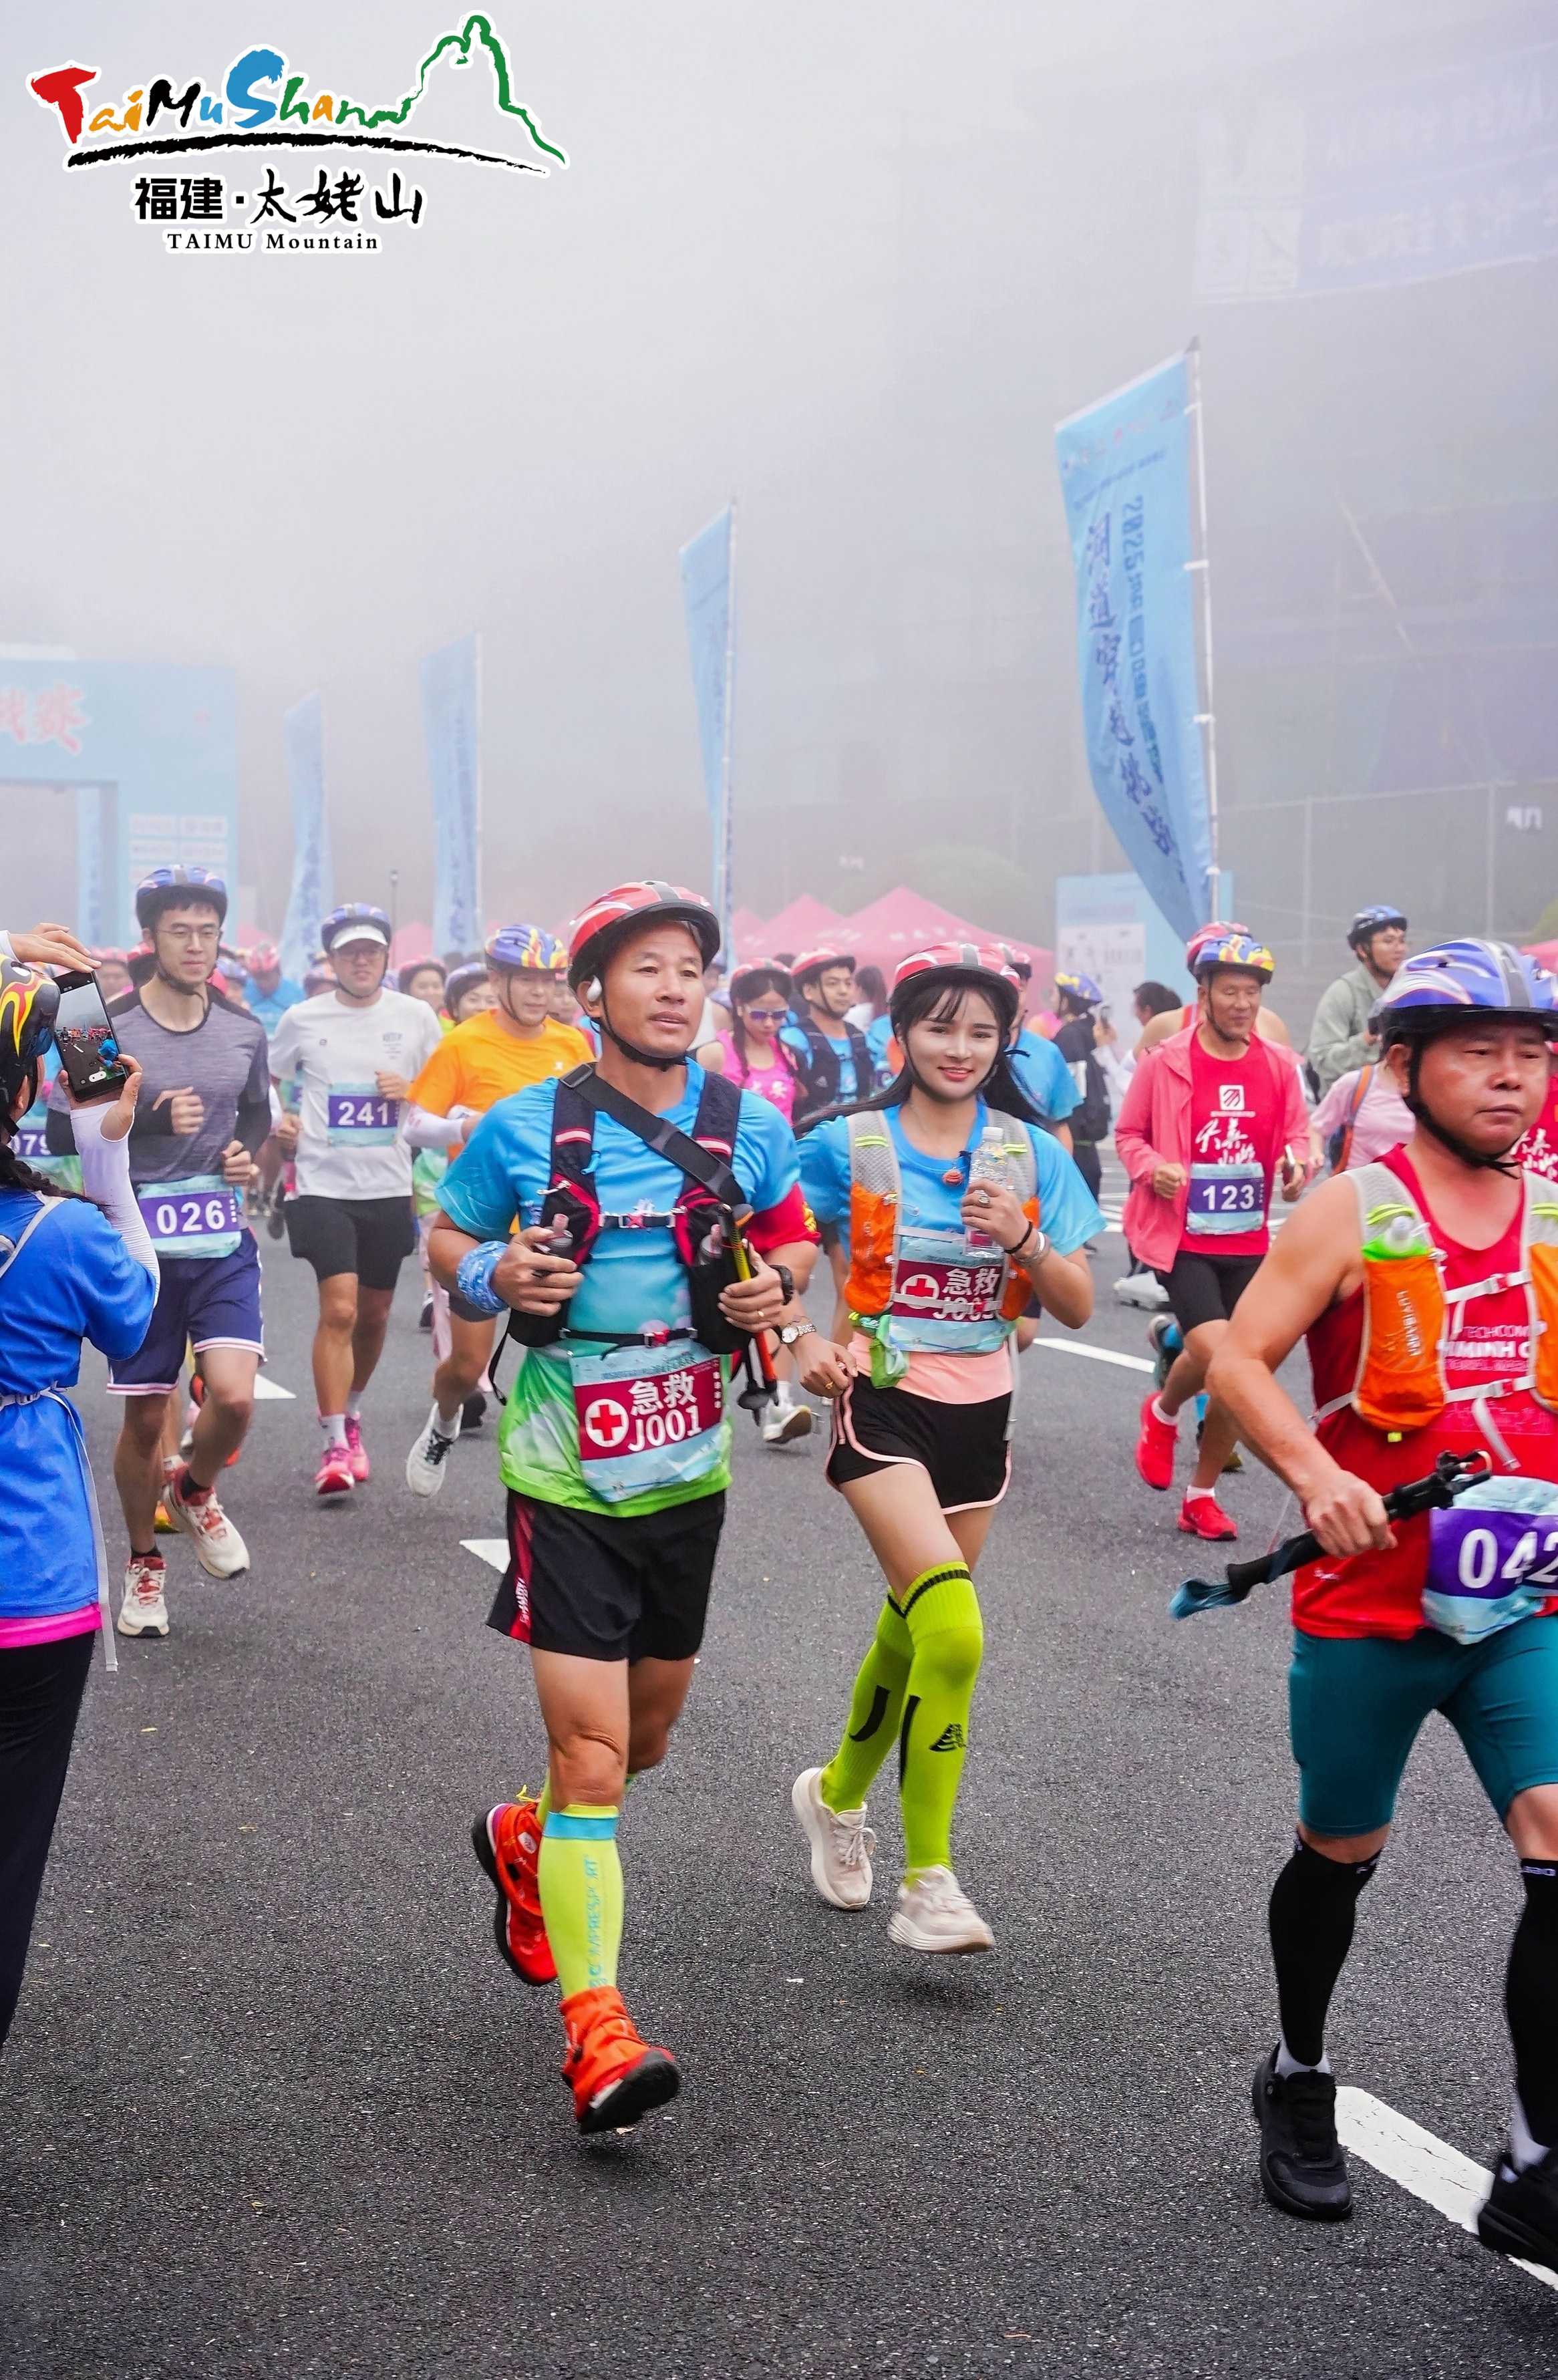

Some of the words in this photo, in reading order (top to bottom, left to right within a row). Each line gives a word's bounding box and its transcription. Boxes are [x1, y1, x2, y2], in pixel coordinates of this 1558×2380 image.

[337, 1101, 388, 1126] 241
[1203, 1184, 1255, 1211] 123
[156, 1199, 225, 1234] 026
[941, 1268, 999, 1296] 急救
[628, 1370, 697, 1417] 急救
[627, 1404, 703, 1452] J001
[1458, 1528, 1558, 1590] 042
